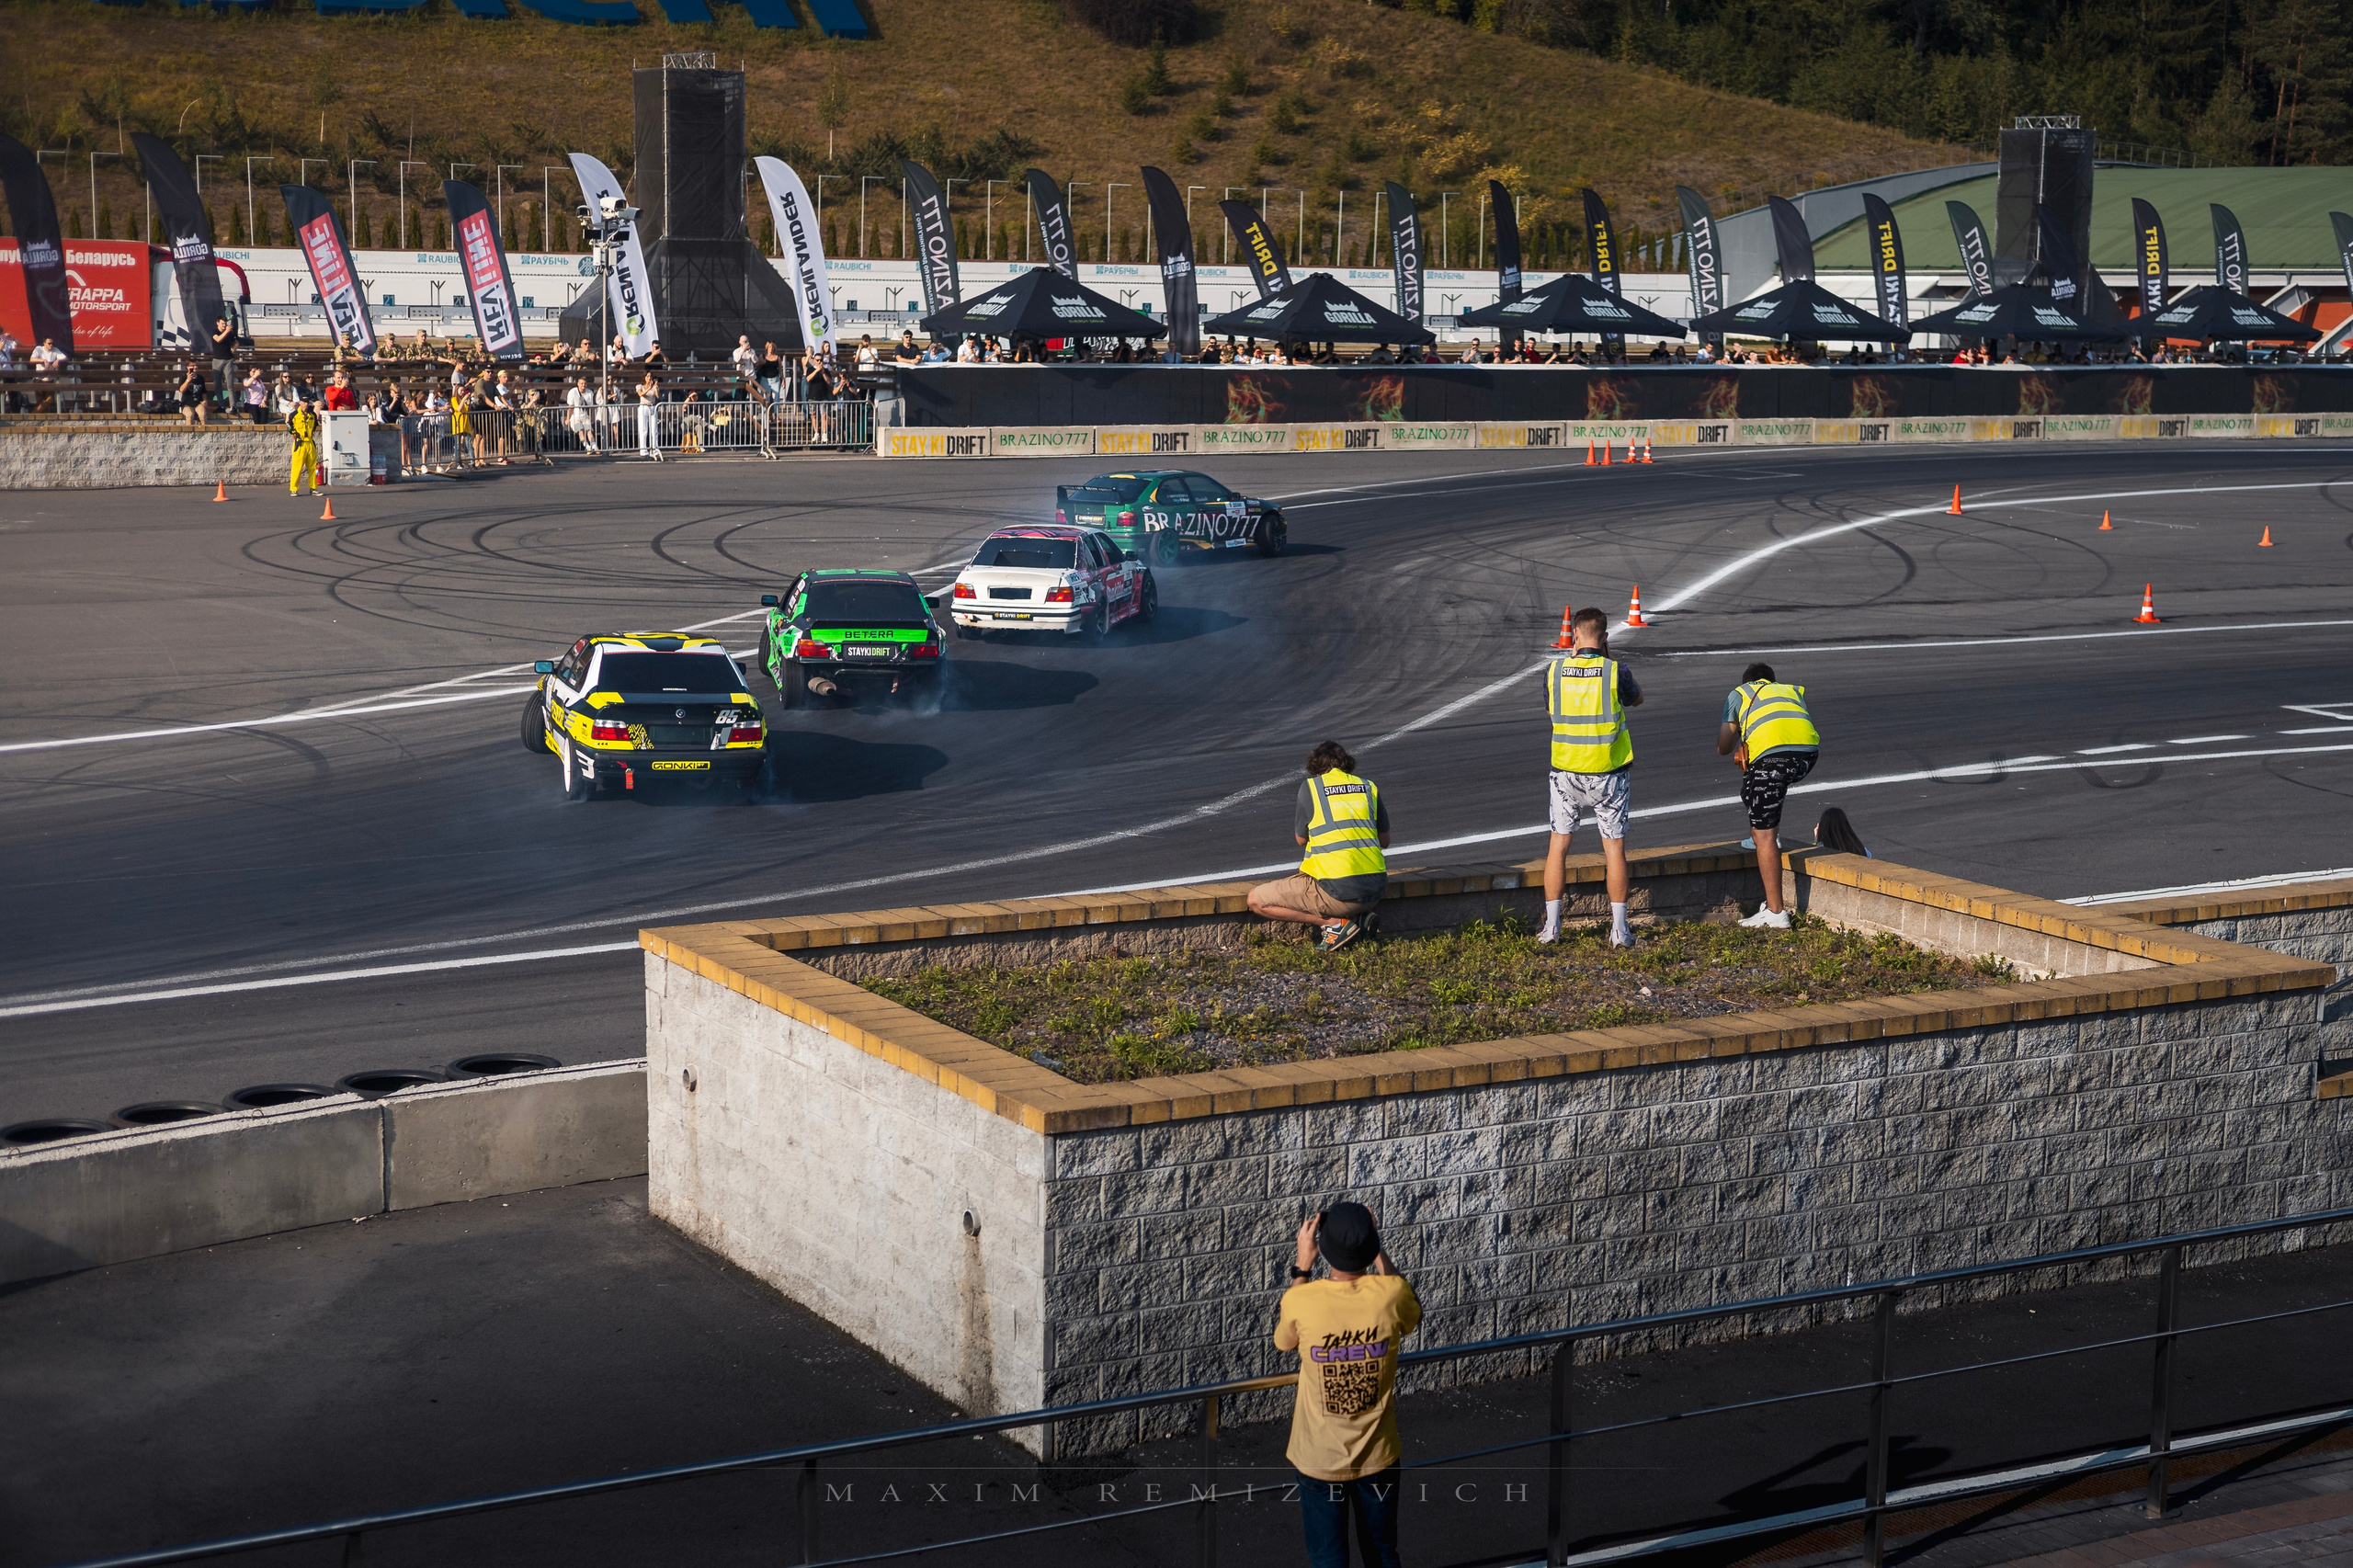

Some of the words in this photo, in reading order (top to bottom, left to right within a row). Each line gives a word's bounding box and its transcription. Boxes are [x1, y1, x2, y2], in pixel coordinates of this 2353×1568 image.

[66, 249, 136, 267] Беларусь
[213, 251, 250, 260] AUBICHI
[428, 256, 460, 264] RAUBIC
[834, 262, 871, 271] RAUBICHI
[1104, 266, 1139, 275] РАЎБІЧЫ
[68, 288, 123, 301] RAPPA
[524, 297, 533, 307] 19
[1051, 306, 1107, 318] GORILLA
[1324, 312, 1378, 324] GORILLA
[1583, 306, 1632, 318] GORILLA
[1813, 312, 1860, 324] GORILLA
[2034, 314, 2078, 326] GORILLA
[2232, 315, 2276, 325] GORILLA
[1901, 422, 1949, 434] BRAZINO
[1949, 422, 1966, 434] 777
[2048, 420, 2093, 433] BRAZINO
[2094, 419, 2111, 431] 777
[2159, 420, 2186, 437] DRIFT
[2193, 419, 2236, 431] BRAZINO
[2237, 418, 2253, 430] 777
[2295, 418, 2321, 435] DRIFT
[2325, 417, 2353, 429] BRAZI
[1392, 428, 1449, 441] BRAZINO
[1449, 427, 1470, 440] 777
[1573, 426, 1628, 438] BRAZINO
[1629, 426, 1648, 438] 777
[1698, 425, 1729, 443] DRIFT
[1741, 424, 1791, 436] BRAZINO
[1792, 424, 1811, 436] 777
[1860, 424, 1890, 441] DRIFT
[2013, 421, 2040, 438] DRIFT
[999, 433, 1063, 448] BRAZINO
[1066, 432, 1088, 446] 777
[1153, 432, 1189, 452] DRIFT
[1203, 430, 1263, 444] BRAZINO
[1265, 430, 1286, 444] 777
[1346, 428, 1380, 449] DRIFT
[1528, 426, 1561, 446] DRIFT
[947, 435, 986, 455] DRIFT
[1230, 515, 1262, 538] 777
[845, 631, 893, 639] BETERA
[1562, 667, 1583, 676] STAYKI
[1584, 667, 1602, 676] DRIFT
[715, 709, 742, 723] 85
[654, 762, 697, 770] GONKI
[1324, 785, 1347, 795] STAYKI
[1347, 784, 1365, 793] DRIFT
[1311, 1339, 1390, 1363] CREW
